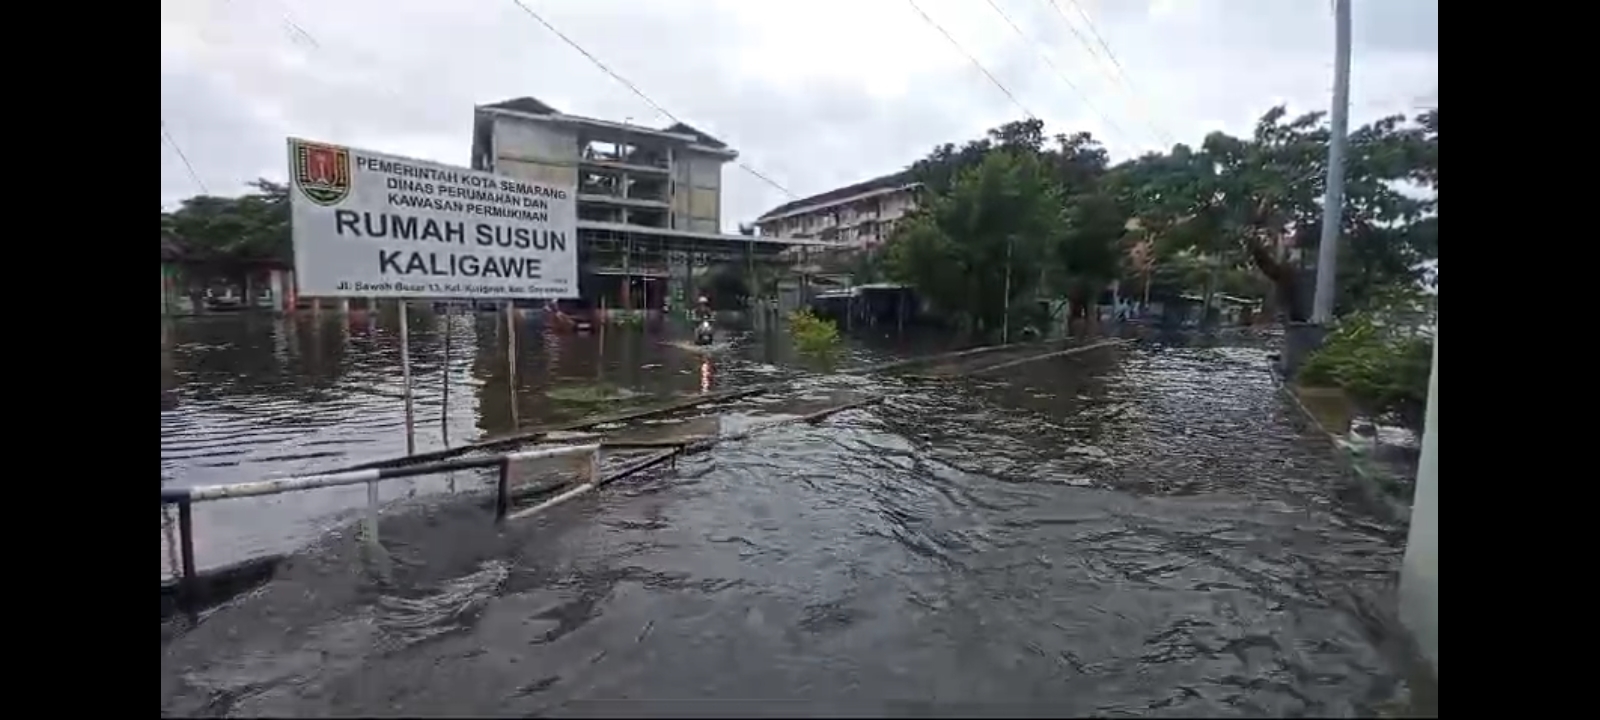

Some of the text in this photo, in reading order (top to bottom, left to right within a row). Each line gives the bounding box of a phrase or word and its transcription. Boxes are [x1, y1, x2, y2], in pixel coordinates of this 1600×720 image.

[357, 157, 566, 199] PEMERINTAH KOTA SEMARANG
[387, 178, 547, 209] DINAS PERUMAHAN DAN
[388, 193, 548, 222] KAWASAN PERMUKIMAN
[335, 210, 566, 252] RUMAH SUSUN
[379, 249, 542, 279] KALIGAWE
